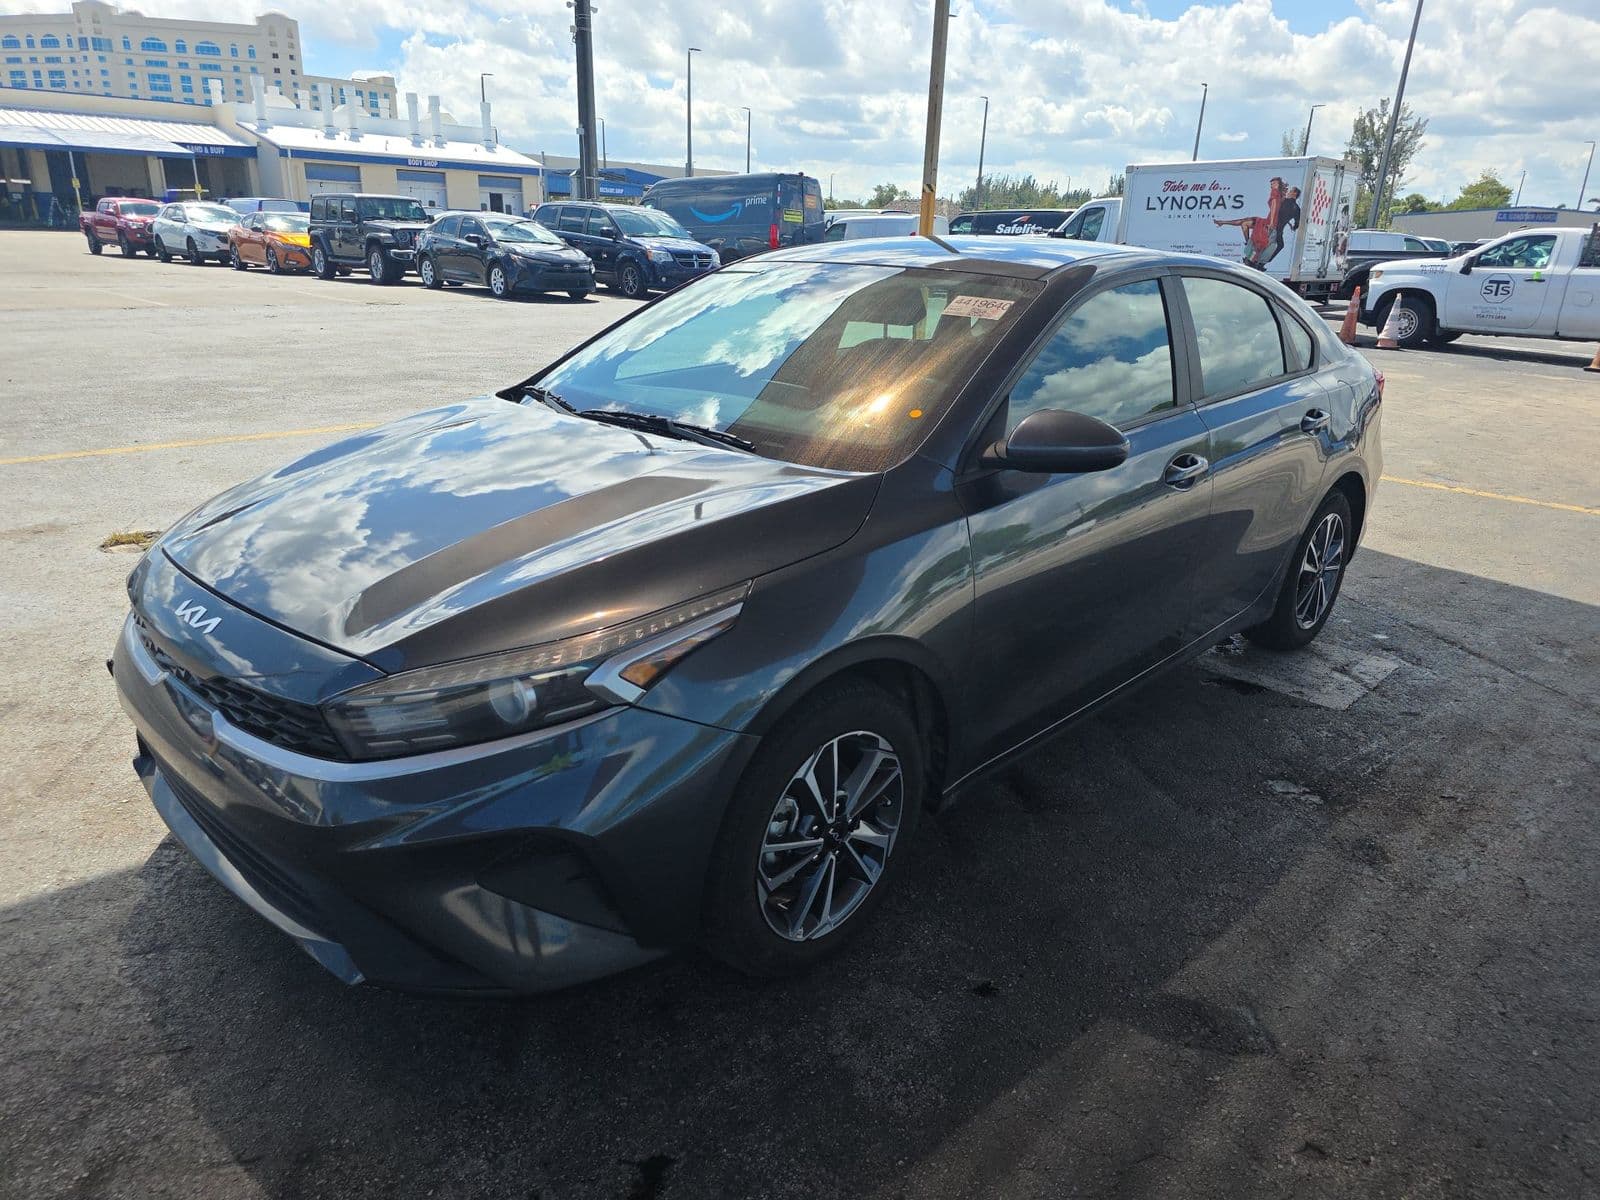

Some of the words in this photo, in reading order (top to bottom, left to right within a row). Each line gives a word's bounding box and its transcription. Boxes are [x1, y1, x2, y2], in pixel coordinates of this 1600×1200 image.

[408, 158, 422, 166] BODY
[423, 160, 438, 168] SHOP
[1162, 180, 1188, 192] Take
[1190, 183, 1206, 191] me
[745, 195, 767, 207] prime
[1146, 194, 1245, 211] LYNORA'S
[1482, 279, 1511, 297] STS
